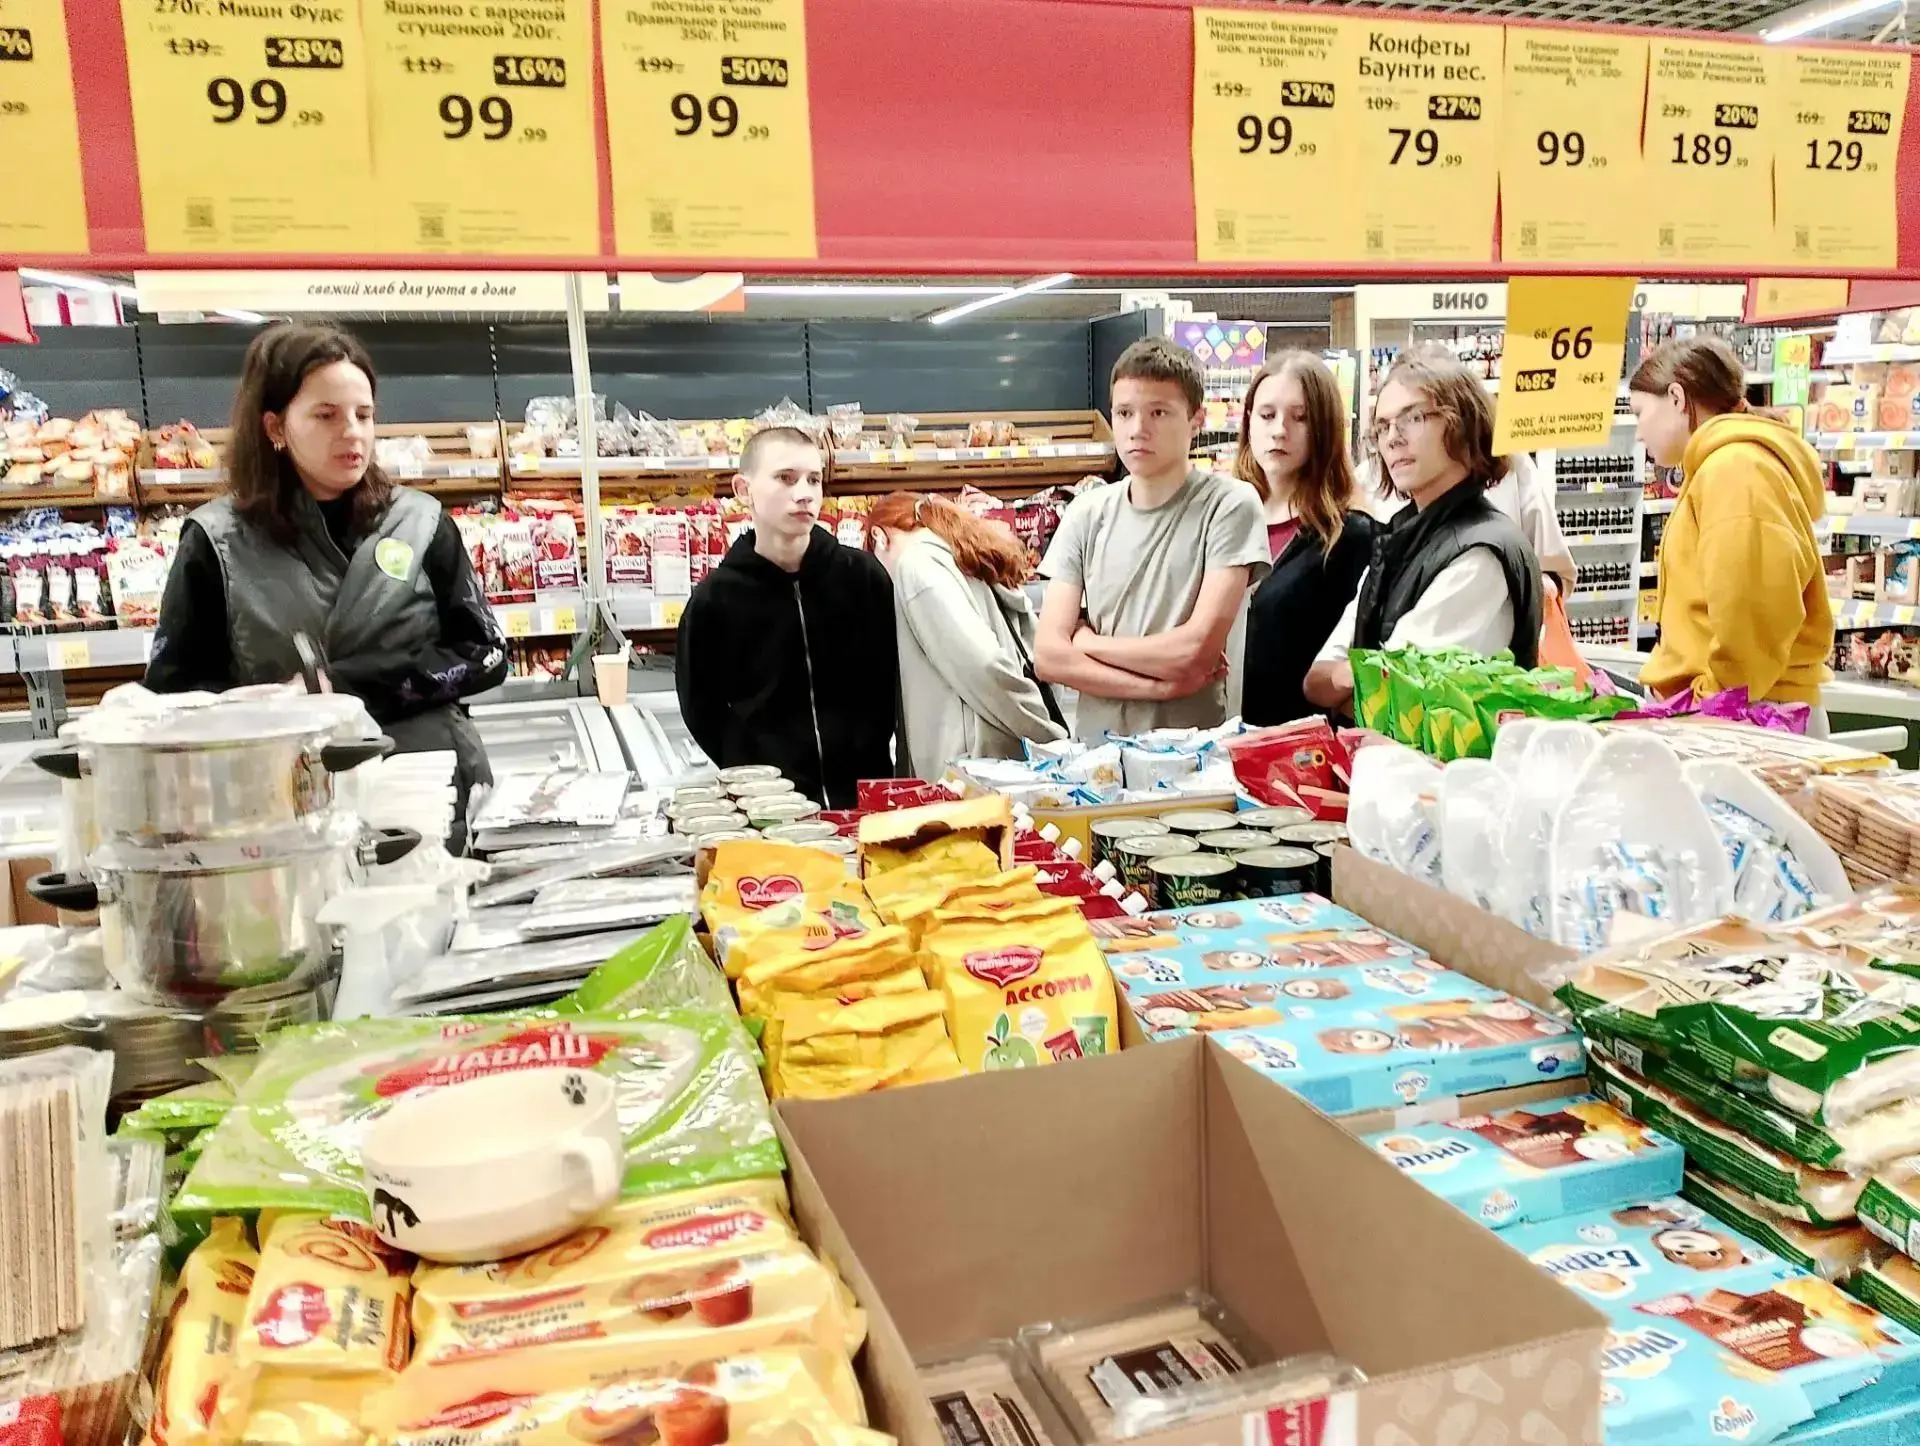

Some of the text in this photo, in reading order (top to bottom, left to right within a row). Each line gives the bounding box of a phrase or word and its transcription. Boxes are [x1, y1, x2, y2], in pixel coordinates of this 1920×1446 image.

[384, 0, 464, 16] Яшкино
[485, 7, 566, 22] вареной
[625, 10, 718, 27] Правильное
[398, 20, 505, 37] сгущенкой
[266, 40, 342, 65] -28%
[1369, 32, 1471, 57] Конфеты
[494, 58, 565, 84] -16%
[721, 58, 788, 84] -50%
[1358, 56, 1487, 82] Баунти вес.
[207, 77, 287, 125] 99
[1282, 82, 1334, 105] -37%
[439, 94, 513, 140] 99
[671, 92, 739, 138] 99
[1428, 96, 1480, 118] -27%
[1715, 104, 1758, 126] -20%
[1237, 115, 1293, 154] 99
[1849, 111, 1891, 132] -23%
[1388, 128, 1439, 166] 79
[1537, 130, 1584, 166] 99
[1671, 132, 1732, 166] 189
[1806, 139, 1863, 171] 129
[307, 281, 517, 298] свежий хлеб для уюта в доме
[1432, 292, 1488, 310] ВИНО
[1005, 974, 1093, 1006] АССОРТИ
[430, 1034, 591, 1072] ЛАВАШ
[1713, 1408, 1755, 1433] Барни
